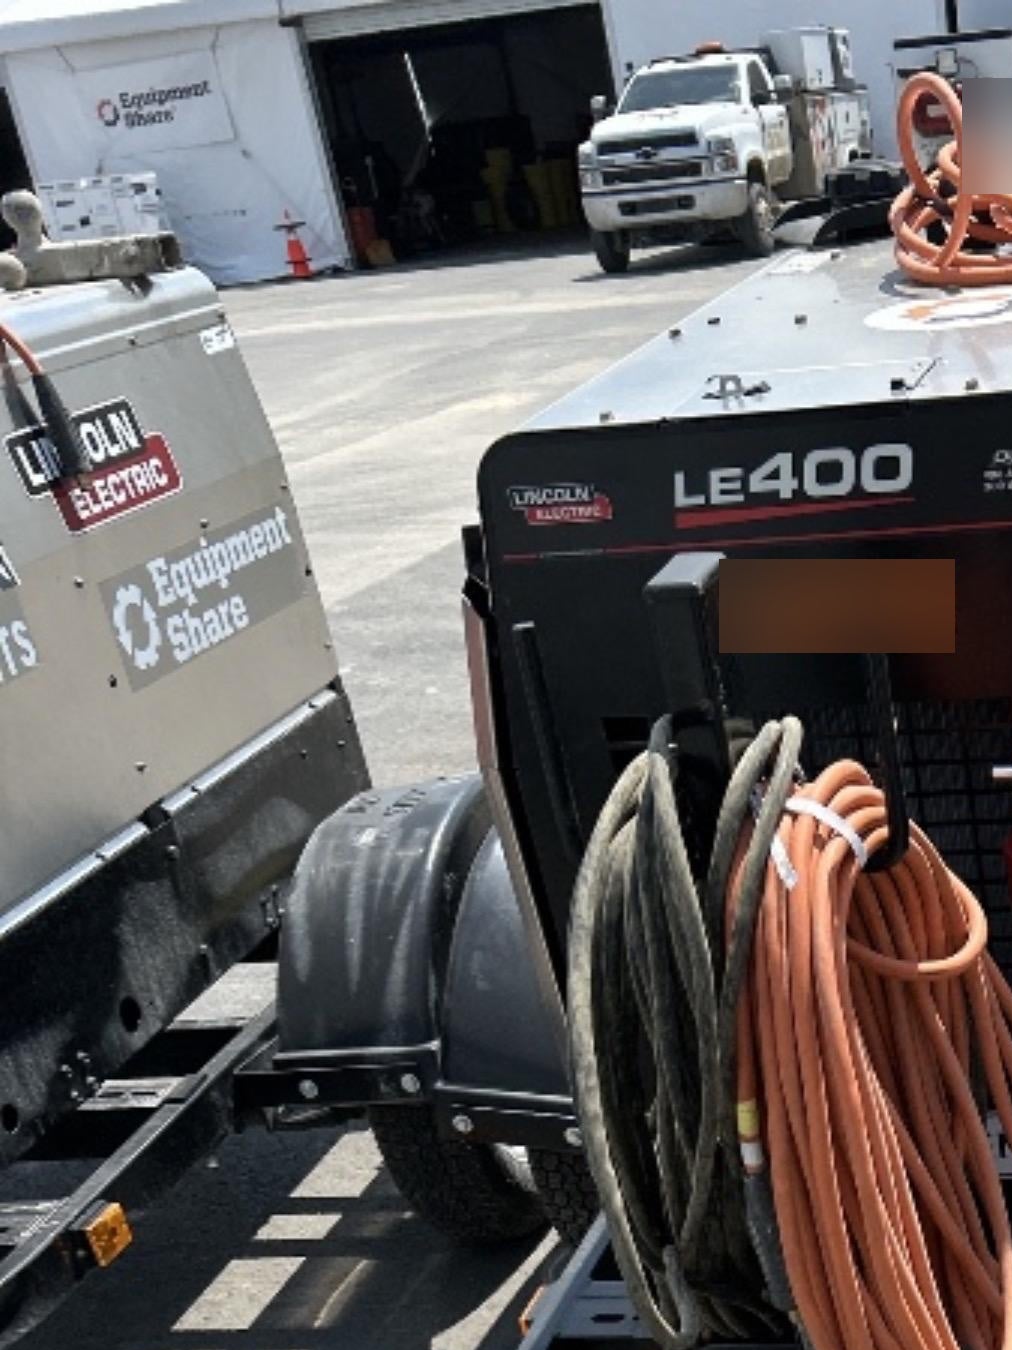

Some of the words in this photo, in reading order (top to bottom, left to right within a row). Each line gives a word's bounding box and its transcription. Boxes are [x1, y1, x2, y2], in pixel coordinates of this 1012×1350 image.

[119, 80, 213, 111] Equipment
[14, 409, 142, 487] LINOLN
[673, 443, 914, 508] LE400
[69, 457, 169, 520] ELECTRIC
[512, 486, 592, 506] LINCOLN
[146, 505, 292, 607] Equipment
[0, 619, 38, 682] TS
[166, 595, 250, 664] Share
